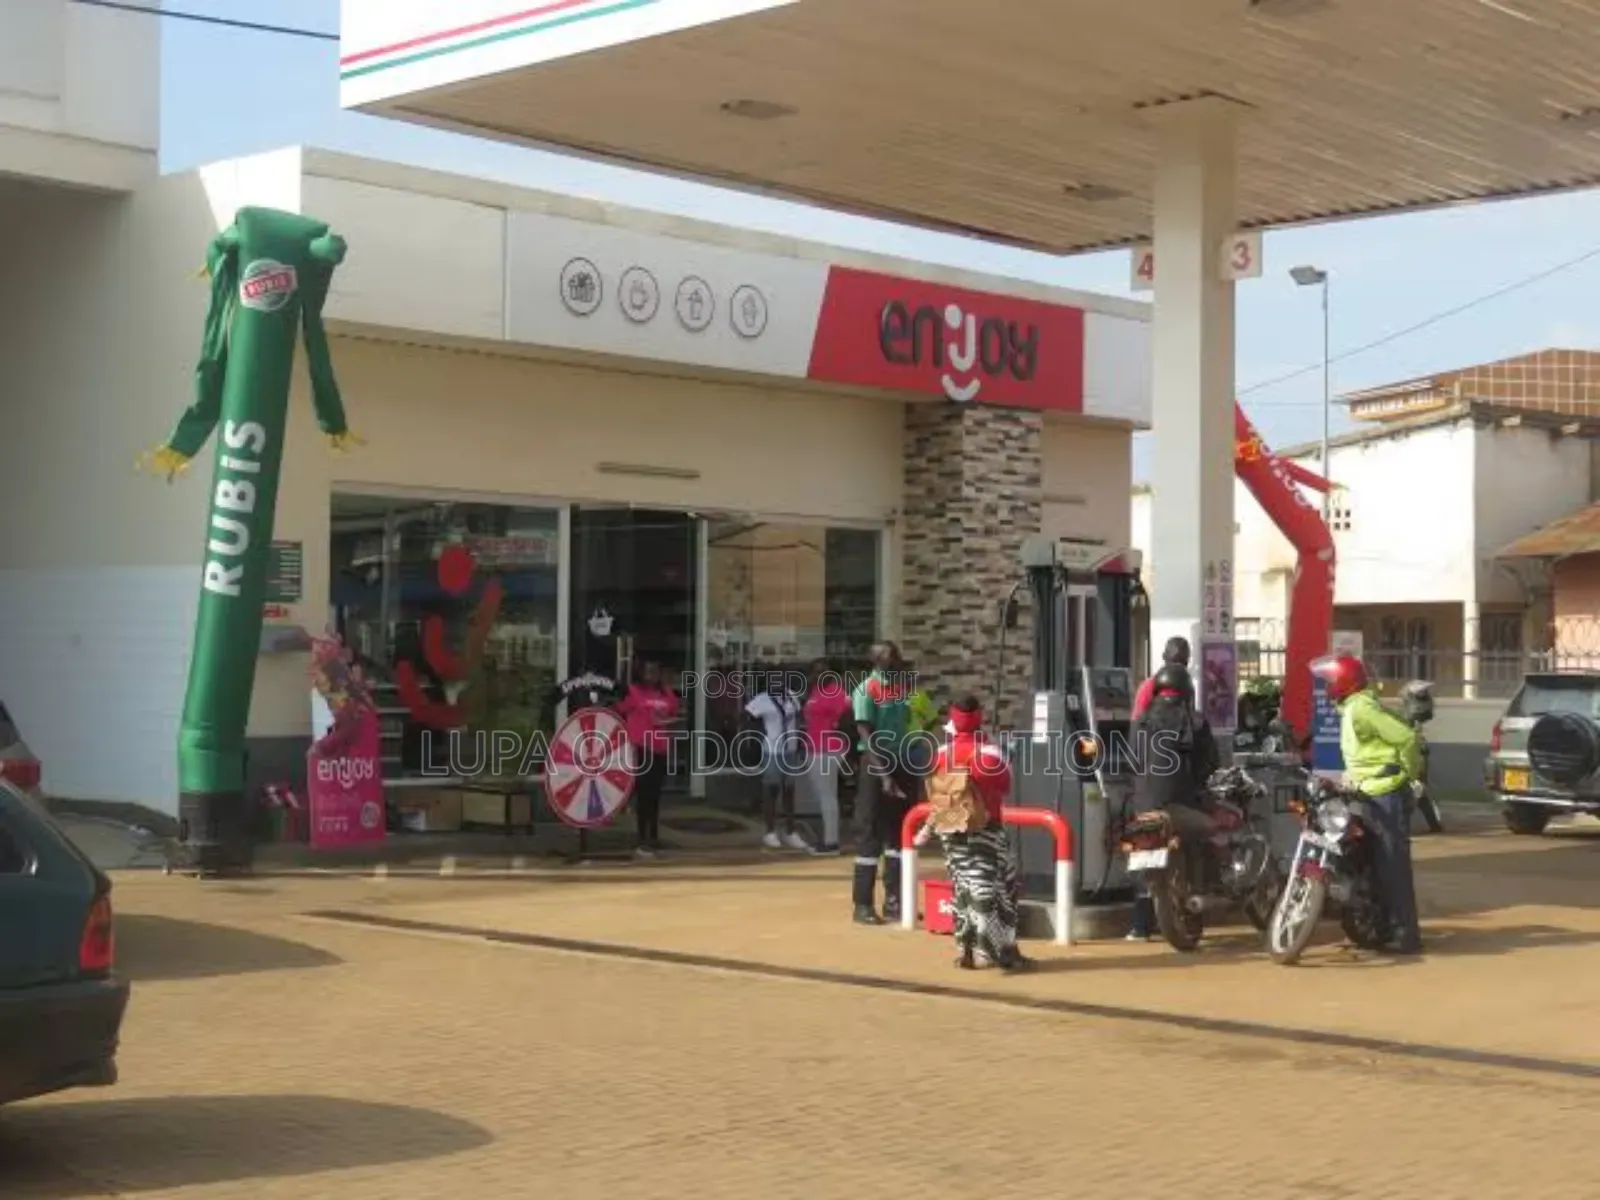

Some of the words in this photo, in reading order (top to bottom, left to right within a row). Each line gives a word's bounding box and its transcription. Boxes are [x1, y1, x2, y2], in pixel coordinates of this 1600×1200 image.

[1137, 254, 1153, 280] 4
[1231, 241, 1252, 271] 3
[880, 300, 1041, 386] enjoy
[204, 419, 266, 597] RUBIS
[317, 757, 375, 787] enjoy
